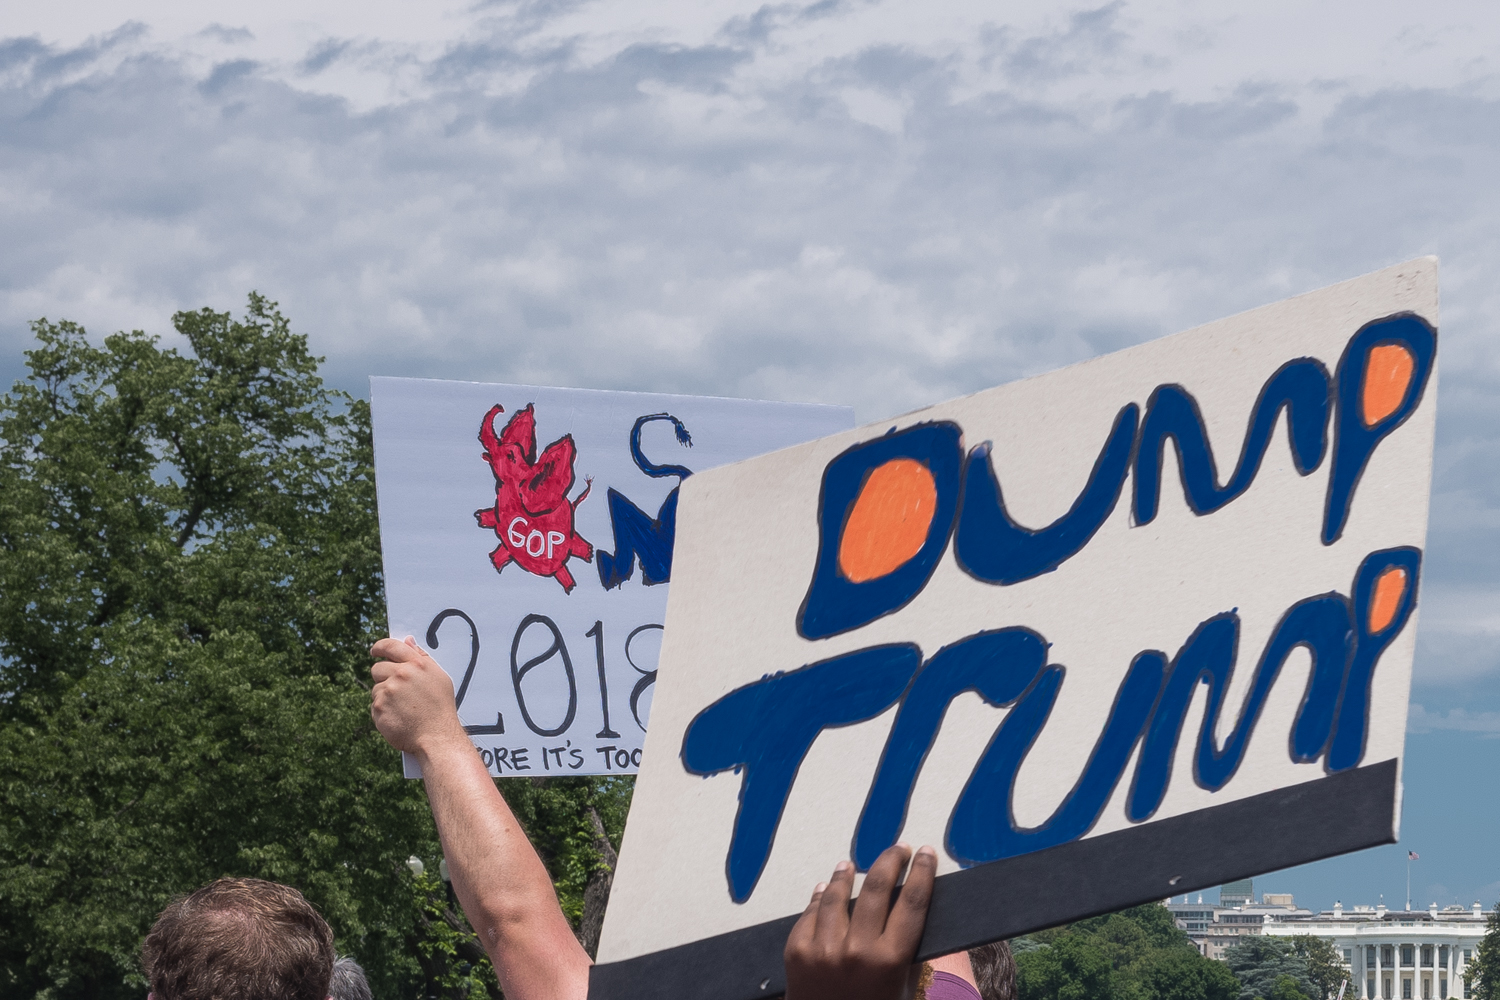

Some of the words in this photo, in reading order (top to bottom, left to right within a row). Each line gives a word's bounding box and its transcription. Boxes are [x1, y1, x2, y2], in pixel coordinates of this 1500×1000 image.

[508, 517, 565, 559] GOP
[426, 608, 664, 738] 2018
[477, 746, 531, 773] ORE
[542, 740, 584, 770] IT'S
[596, 746, 642, 770] TOO
